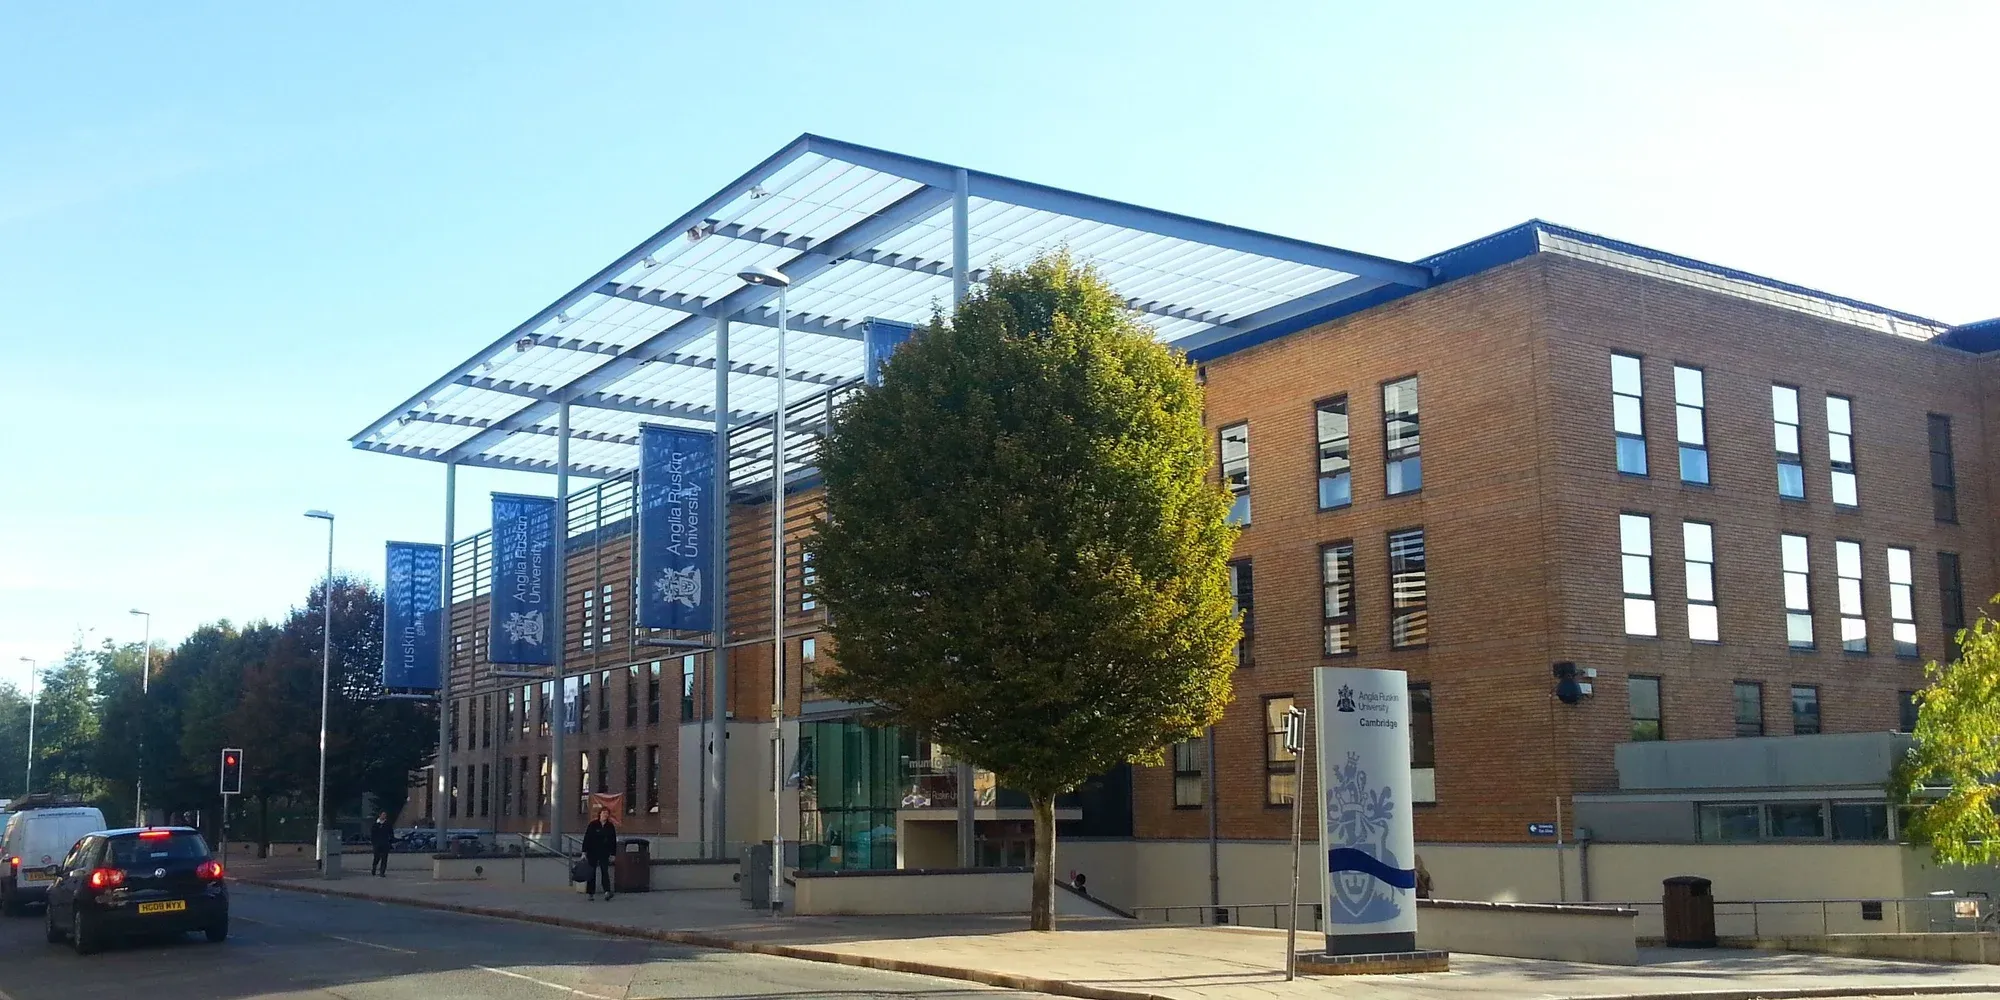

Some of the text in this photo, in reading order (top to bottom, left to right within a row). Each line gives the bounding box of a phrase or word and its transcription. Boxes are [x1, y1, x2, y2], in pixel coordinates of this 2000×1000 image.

[666, 452, 685, 556] Anglia Ruskin
[685, 482, 702, 558] University
[513, 516, 529, 602] Anglia Ruskin
[529, 541, 543, 604] University
[402, 626, 415, 668] ruskin
[1358, 702, 1389, 713] University
[1359, 691, 1399, 703] Anglia Ruskin
[1360, 717, 1398, 730] Cambridge
